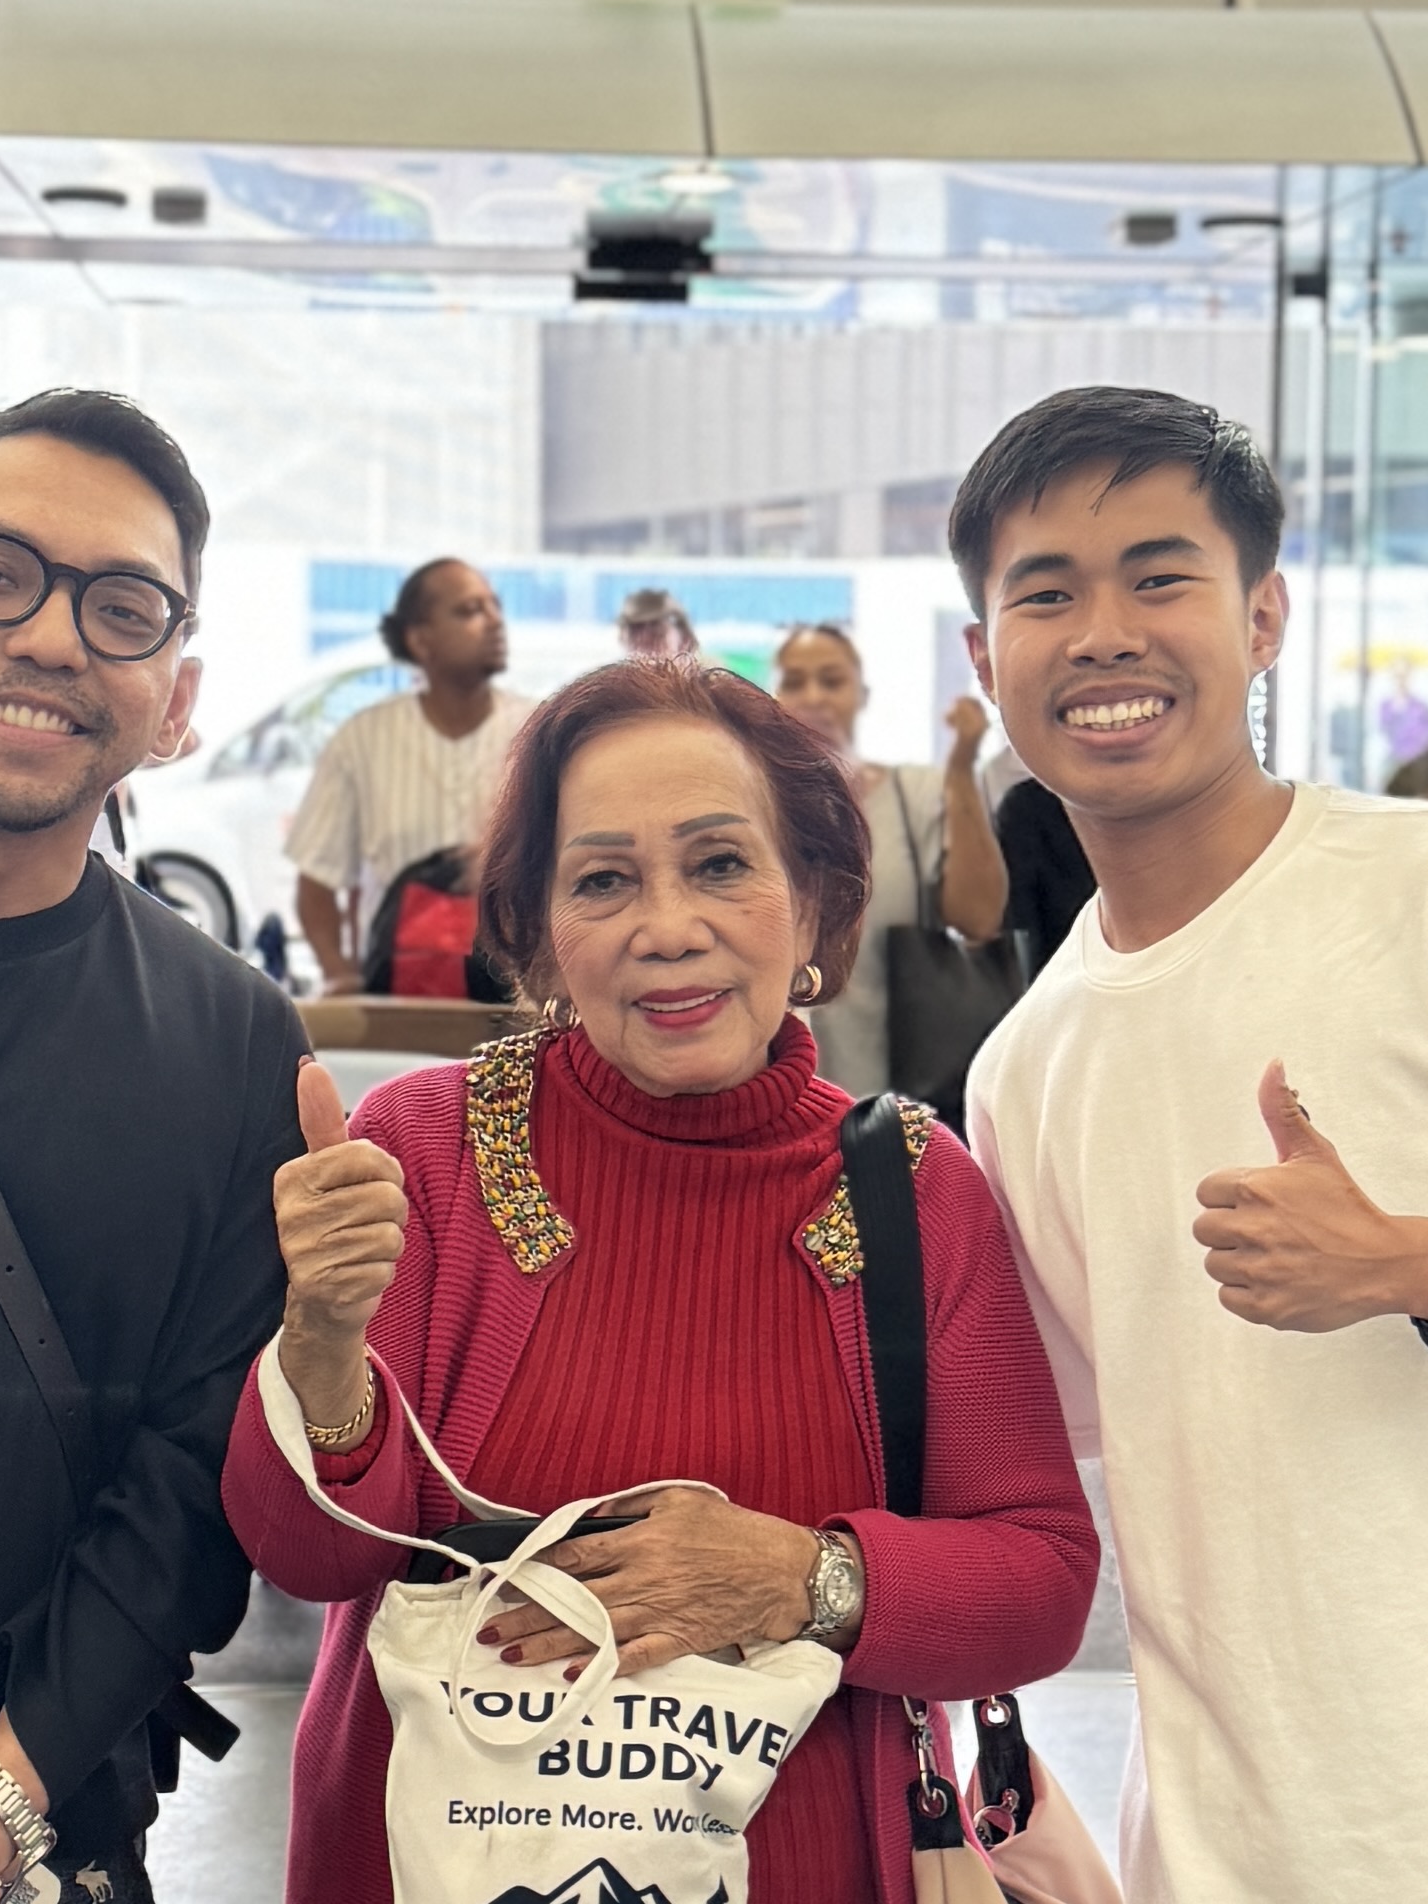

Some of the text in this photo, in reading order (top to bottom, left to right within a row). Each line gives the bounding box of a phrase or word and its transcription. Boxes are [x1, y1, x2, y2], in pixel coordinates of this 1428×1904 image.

[614, 1694, 793, 1771] TRAVE
[538, 1738, 724, 1791] BUDDY
[448, 1800, 552, 1831] Explore
[562, 1804, 643, 1832] More.
